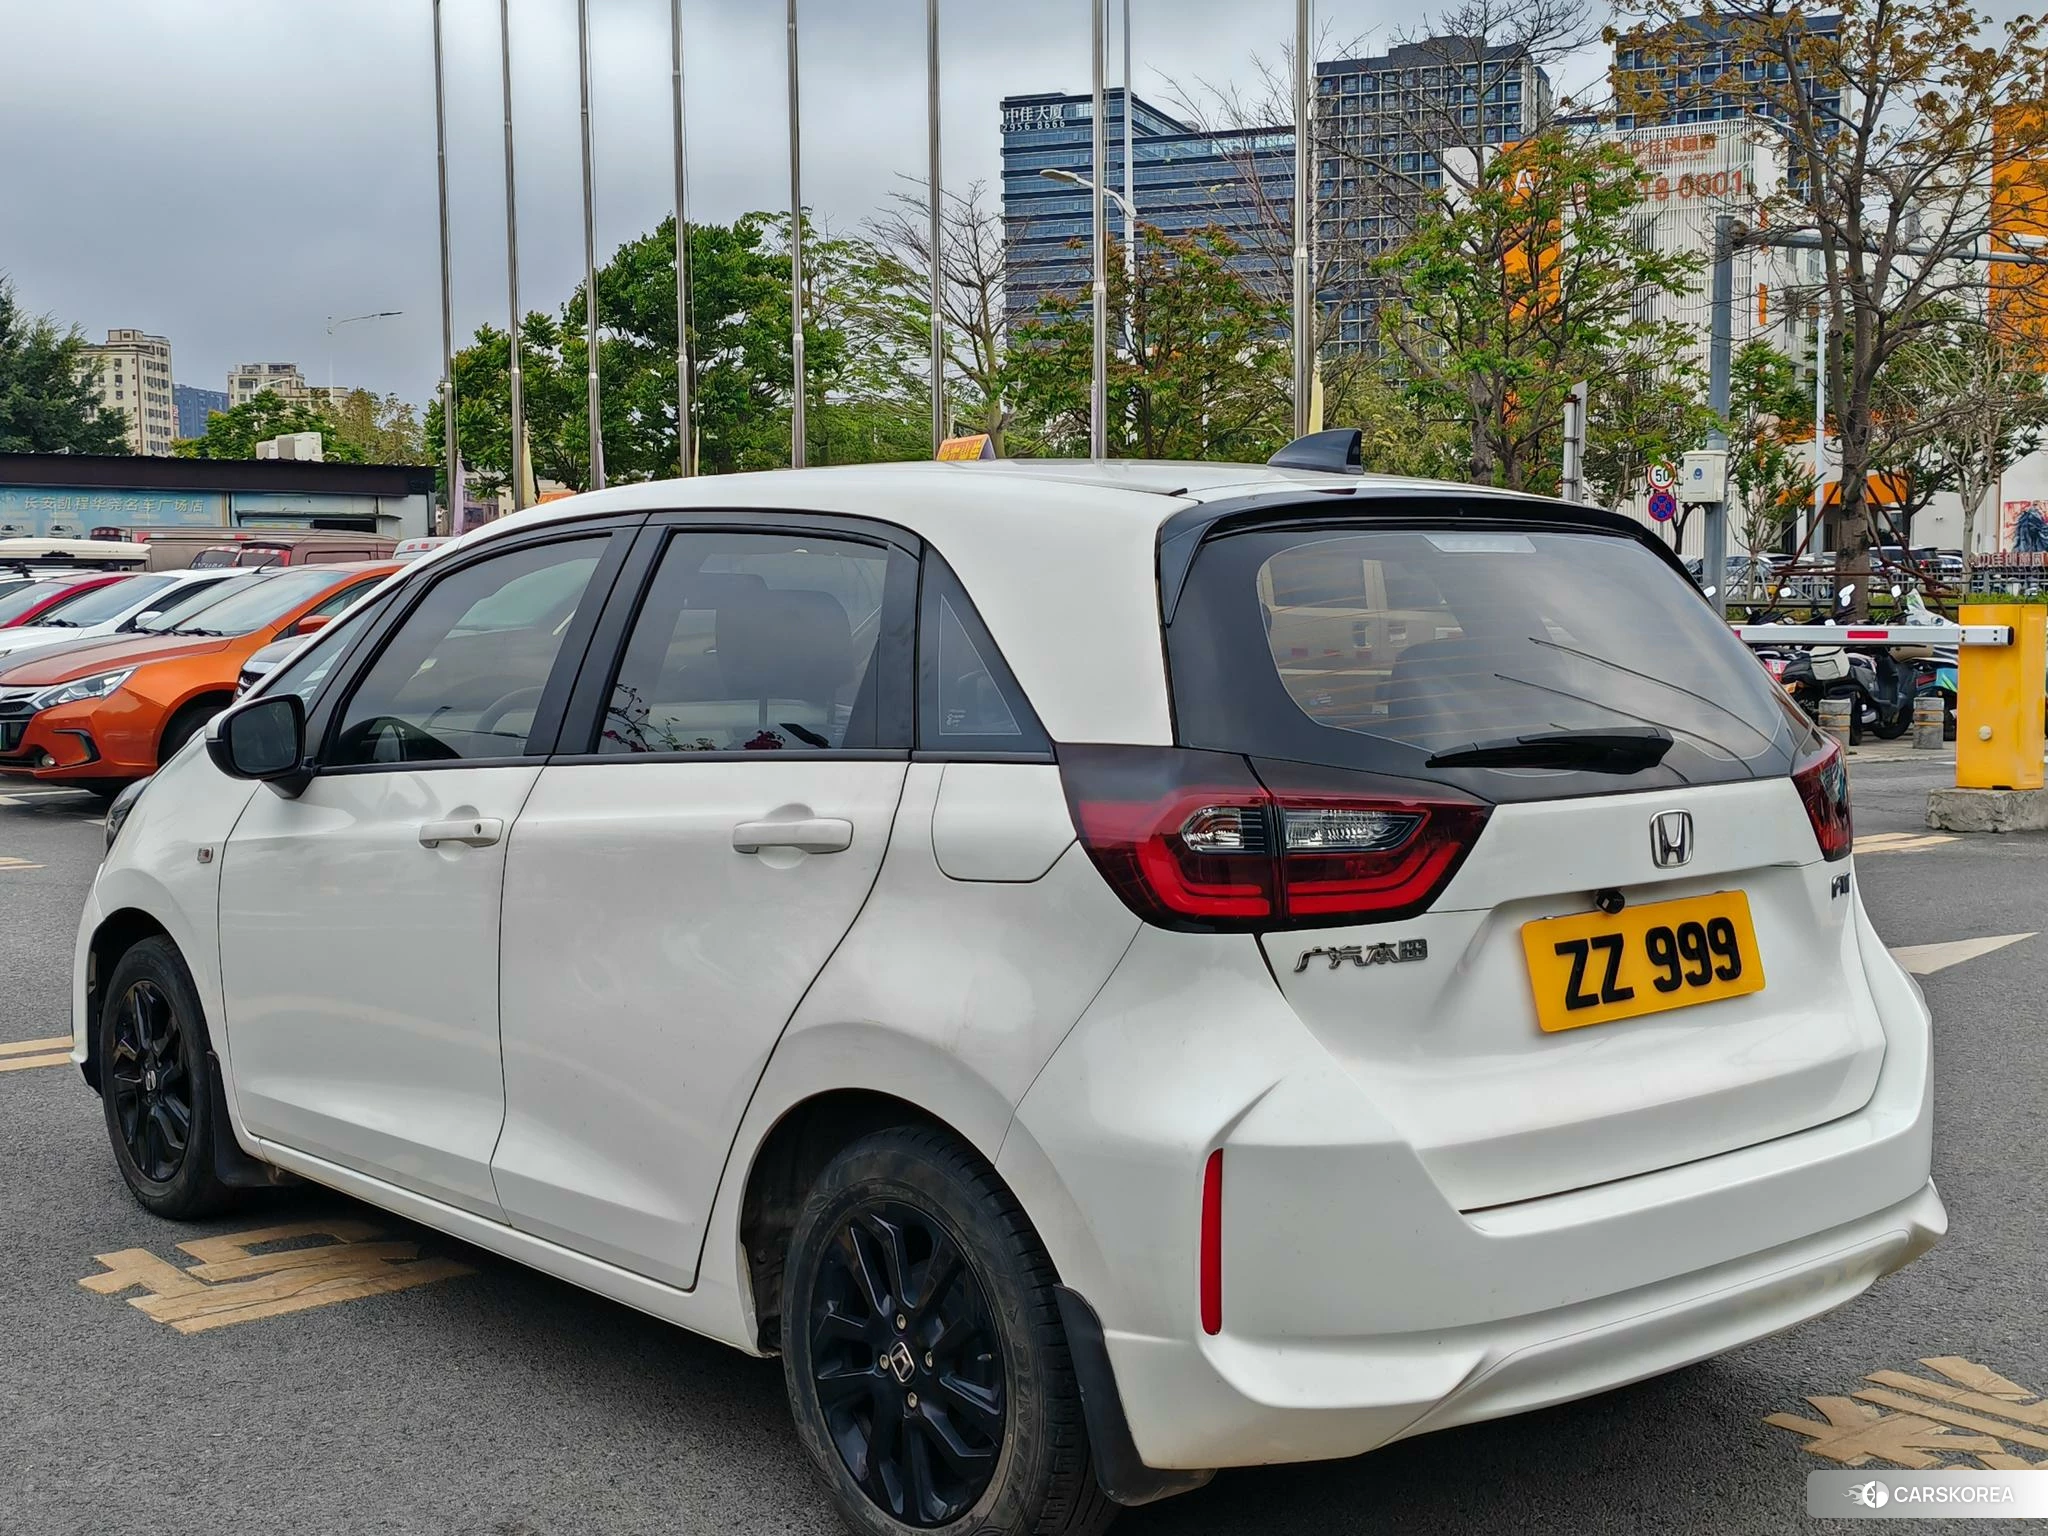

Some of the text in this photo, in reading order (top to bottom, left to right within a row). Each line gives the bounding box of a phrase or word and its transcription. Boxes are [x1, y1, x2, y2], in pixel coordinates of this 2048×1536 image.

[1006, 104, 1063, 123] 中佳大厦
[1001, 119, 1066, 133] 2956 8666
[1655, 469, 1669, 483] 50
[1294, 938, 1428, 972] 广汽本田
[1554, 916, 1742, 1011] ZZ 999
